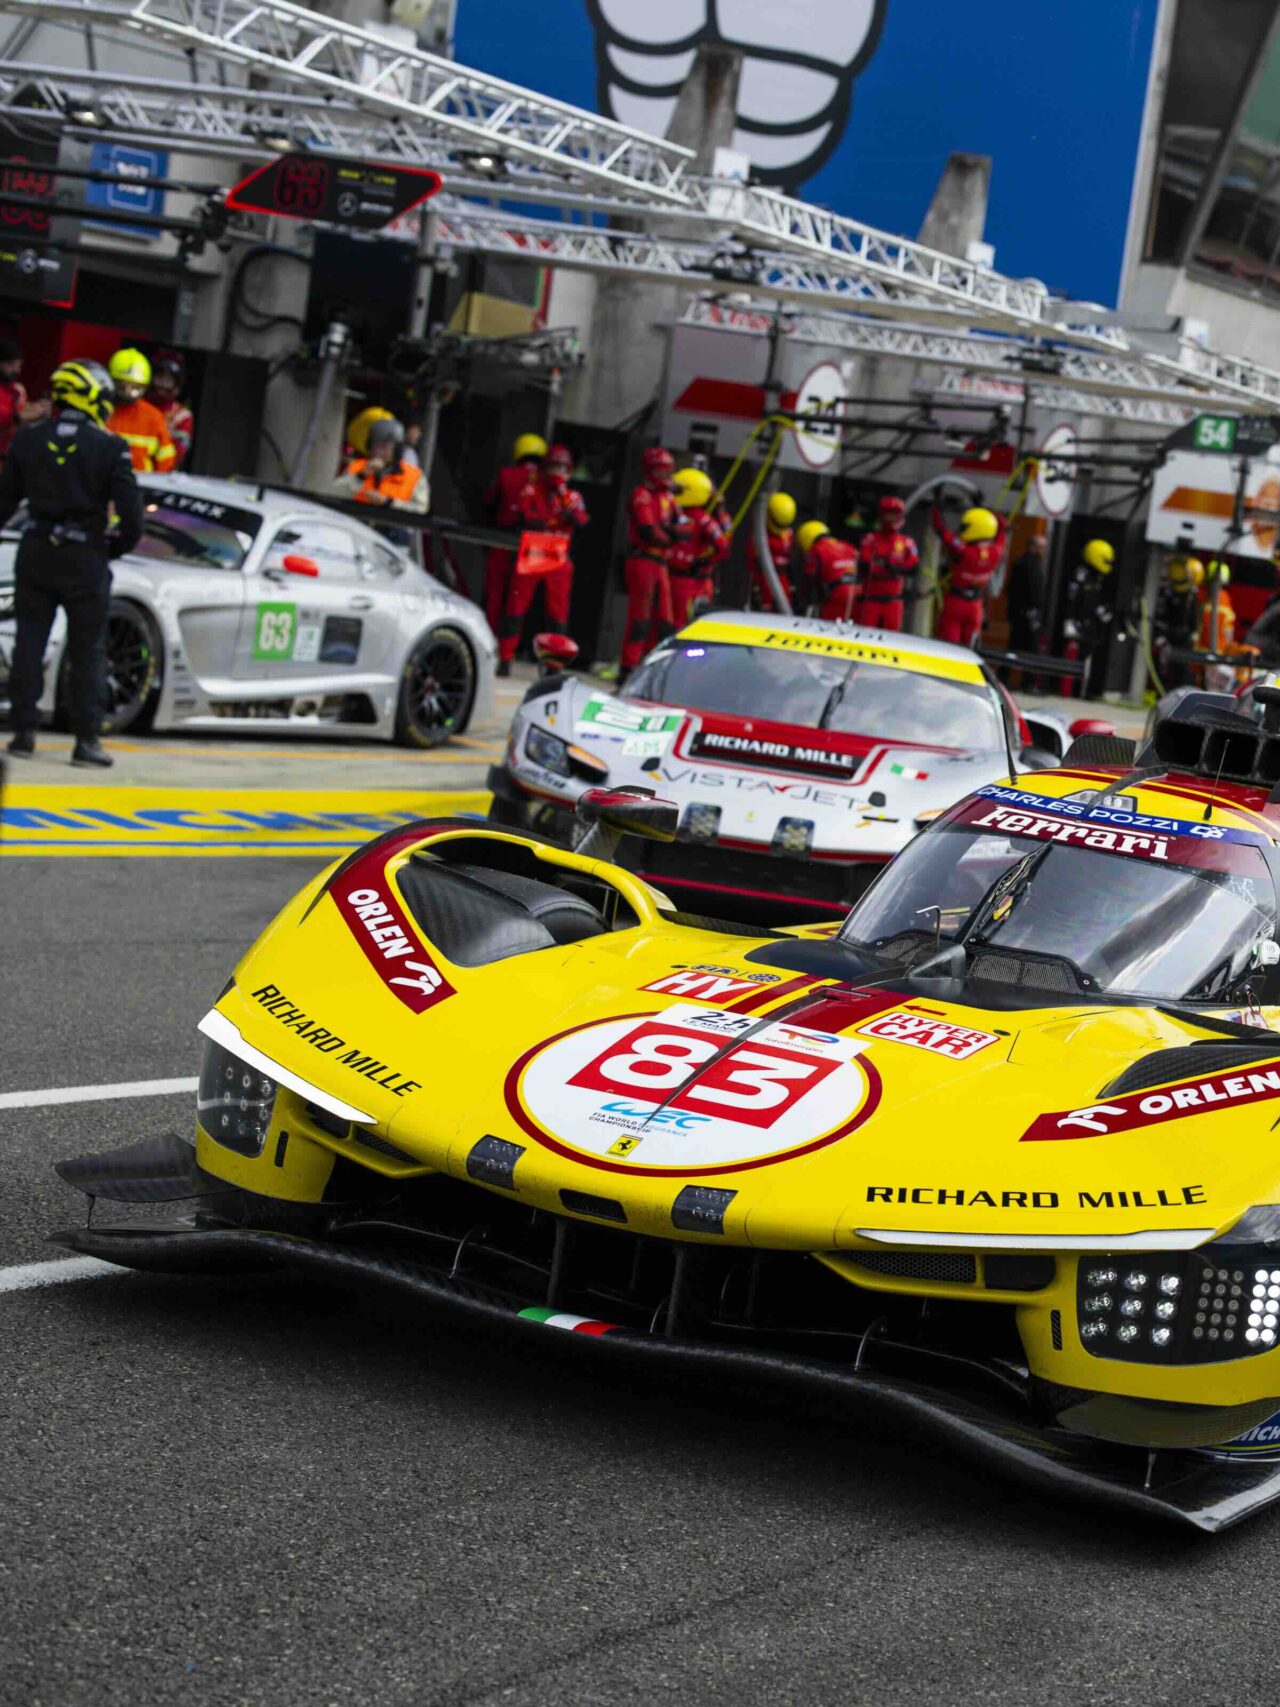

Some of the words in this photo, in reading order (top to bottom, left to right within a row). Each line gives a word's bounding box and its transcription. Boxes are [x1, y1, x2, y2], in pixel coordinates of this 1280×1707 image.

[1200, 418, 1229, 447] 54
[259, 611, 292, 651] 63
[704, 733, 790, 757] RICHARD
[793, 747, 853, 768] MILLE
[977, 786, 1084, 816] CHARLES
[1088, 809, 1179, 832] POZZI
[971, 804, 1170, 860] Ferrari
[347, 888, 415, 959] ORLEN
[653, 971, 761, 1000] HY
[251, 984, 347, 1053] RICHARD
[336, 1049, 422, 1097] MILLE
[870, 1022, 973, 1055] CAR
[889, 1014, 988, 1043] HYPER
[600, 1034, 820, 1110] 83
[607, 1114, 638, 1126] WORLD
[866, 1186, 1060, 1209] RICHARD
[1079, 1185, 1208, 1209] MILLE
